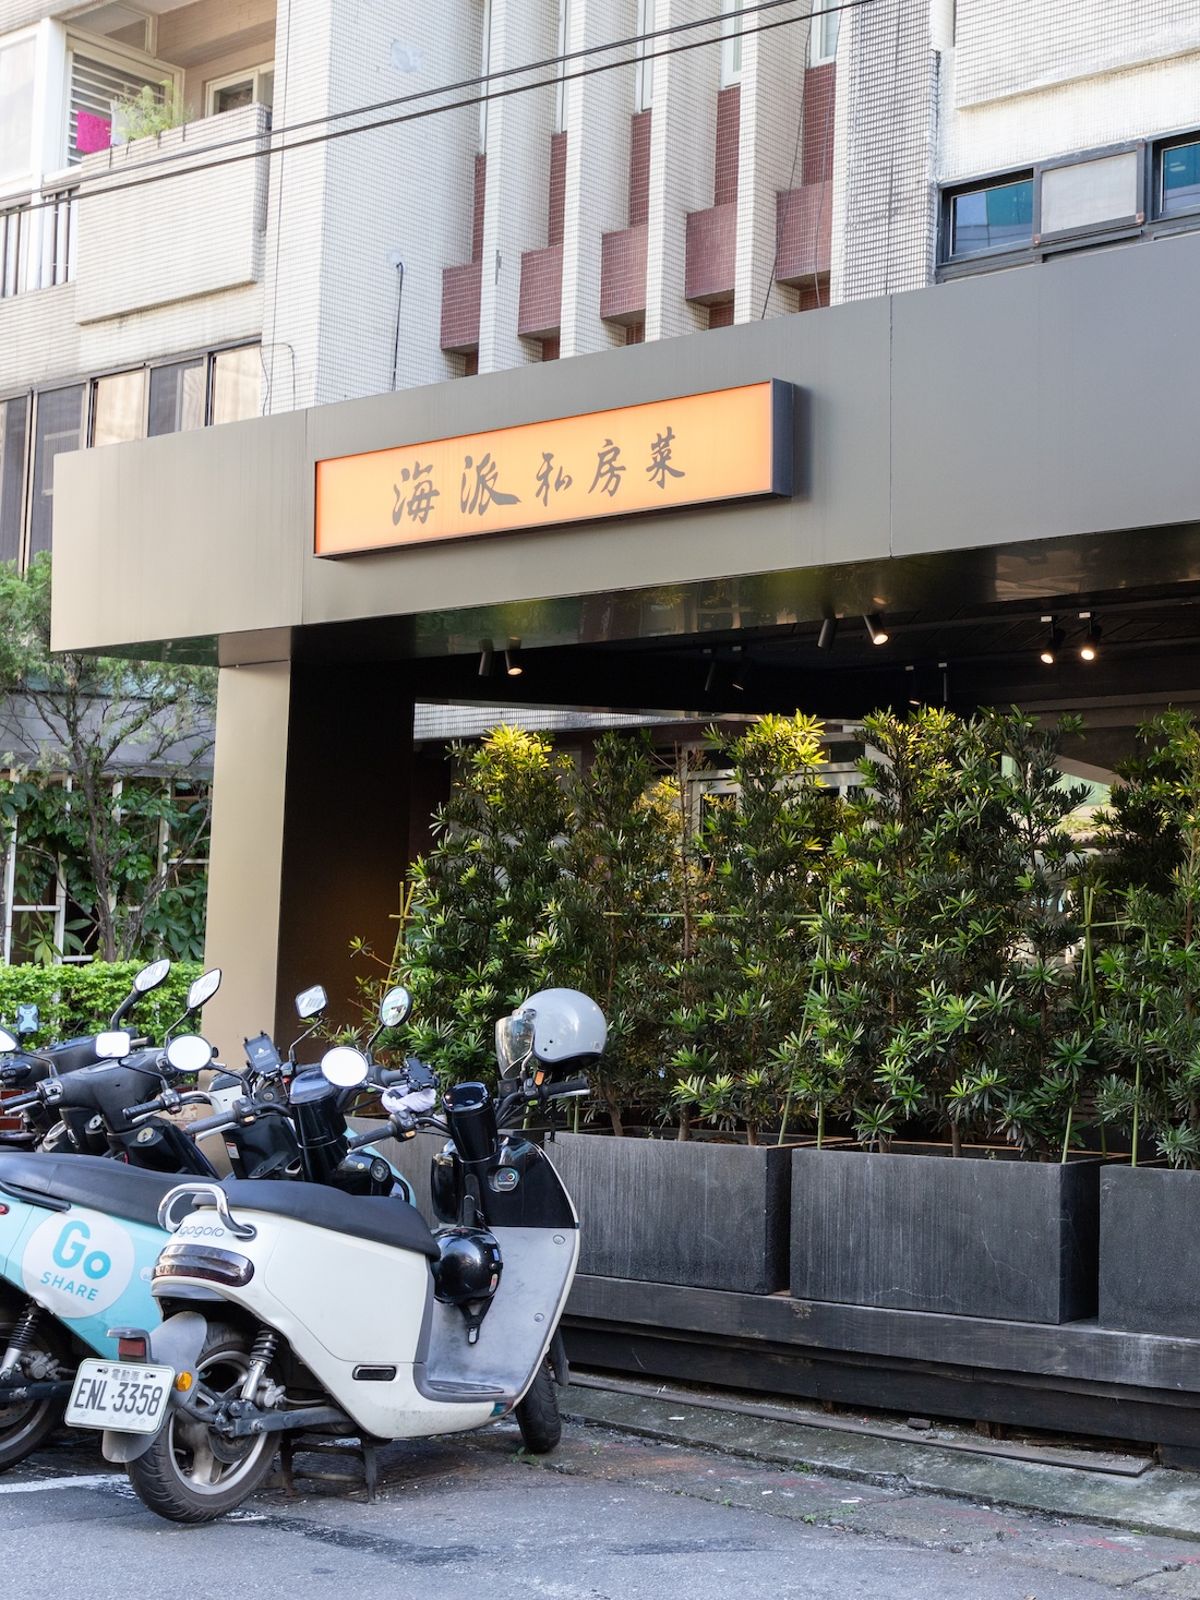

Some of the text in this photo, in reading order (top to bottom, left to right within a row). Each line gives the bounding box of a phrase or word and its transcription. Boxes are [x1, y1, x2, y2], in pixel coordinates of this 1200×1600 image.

[392, 426, 686, 526] 海派私房菜
[53, 1220, 112, 1280] Go
[178, 1225, 225, 1239] gogoro
[40, 1271, 99, 1301] SHARE
